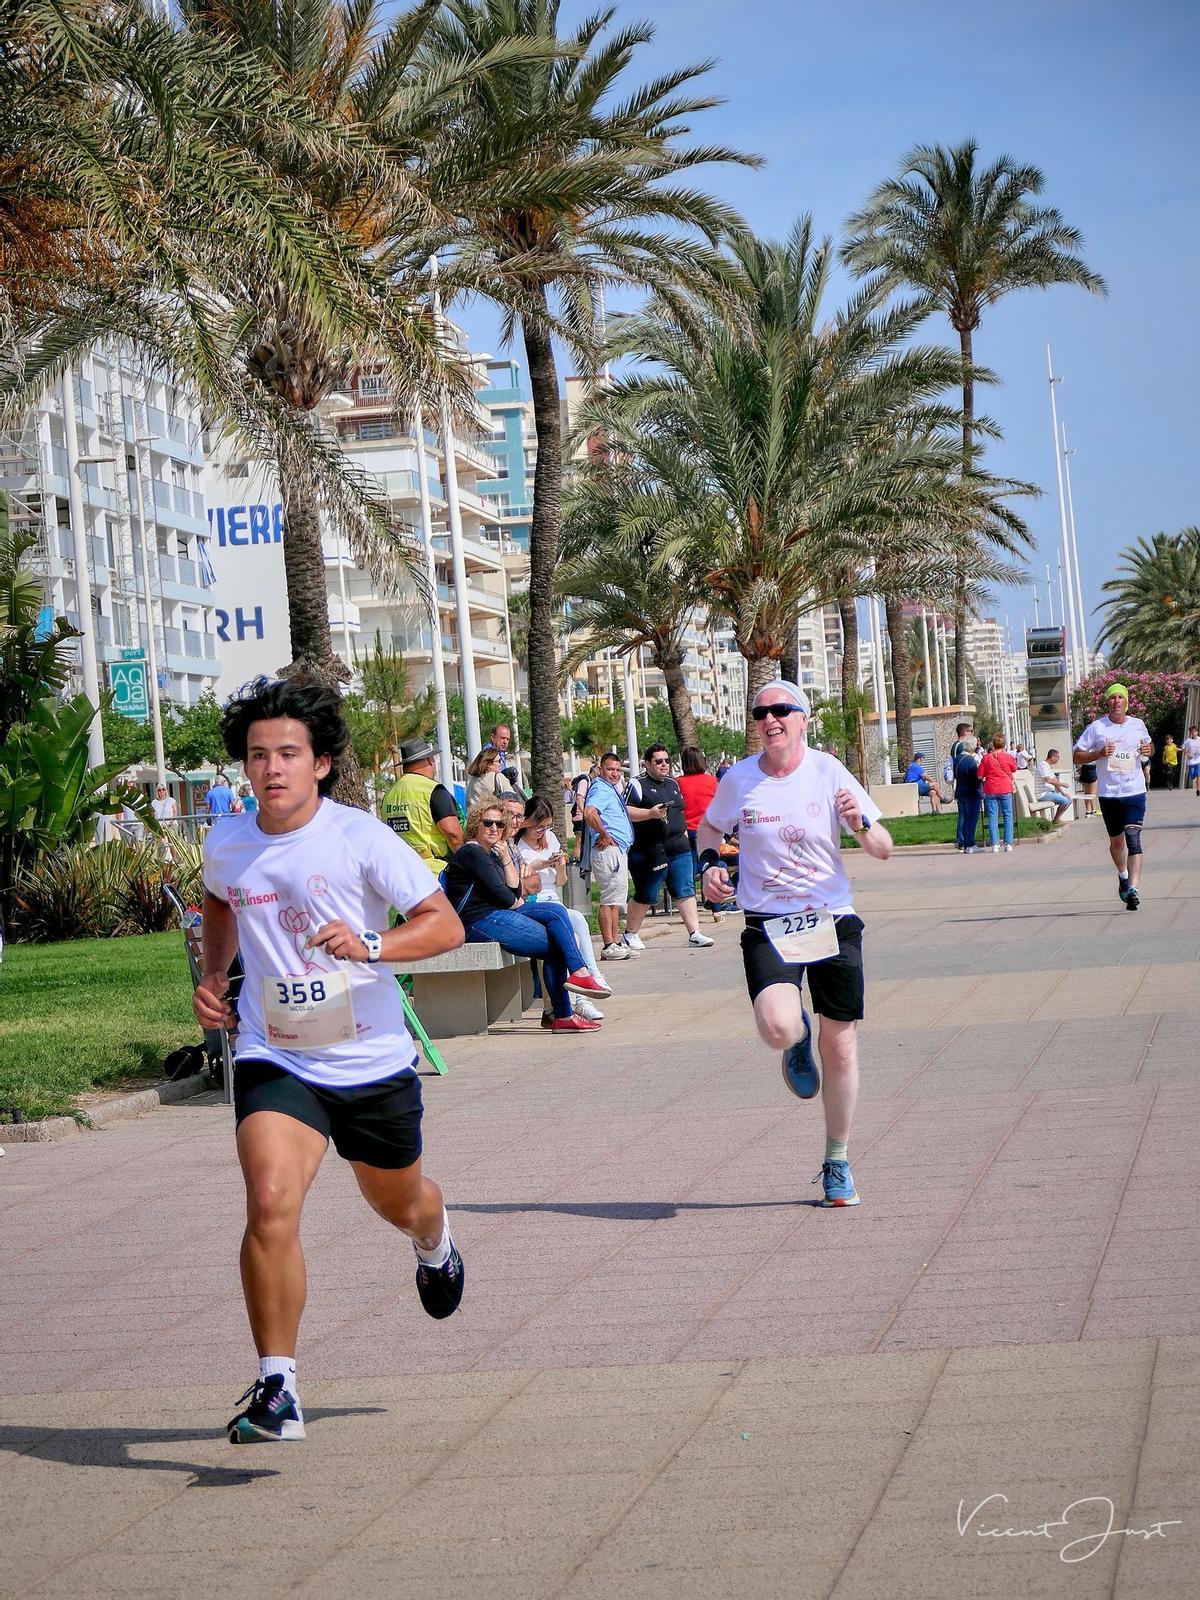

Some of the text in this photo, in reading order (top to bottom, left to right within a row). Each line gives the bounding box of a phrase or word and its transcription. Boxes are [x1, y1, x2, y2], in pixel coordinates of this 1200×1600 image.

[227, 886, 242, 898] Run
[783, 912, 818, 934] 225
[277, 980, 326, 1004] 358
